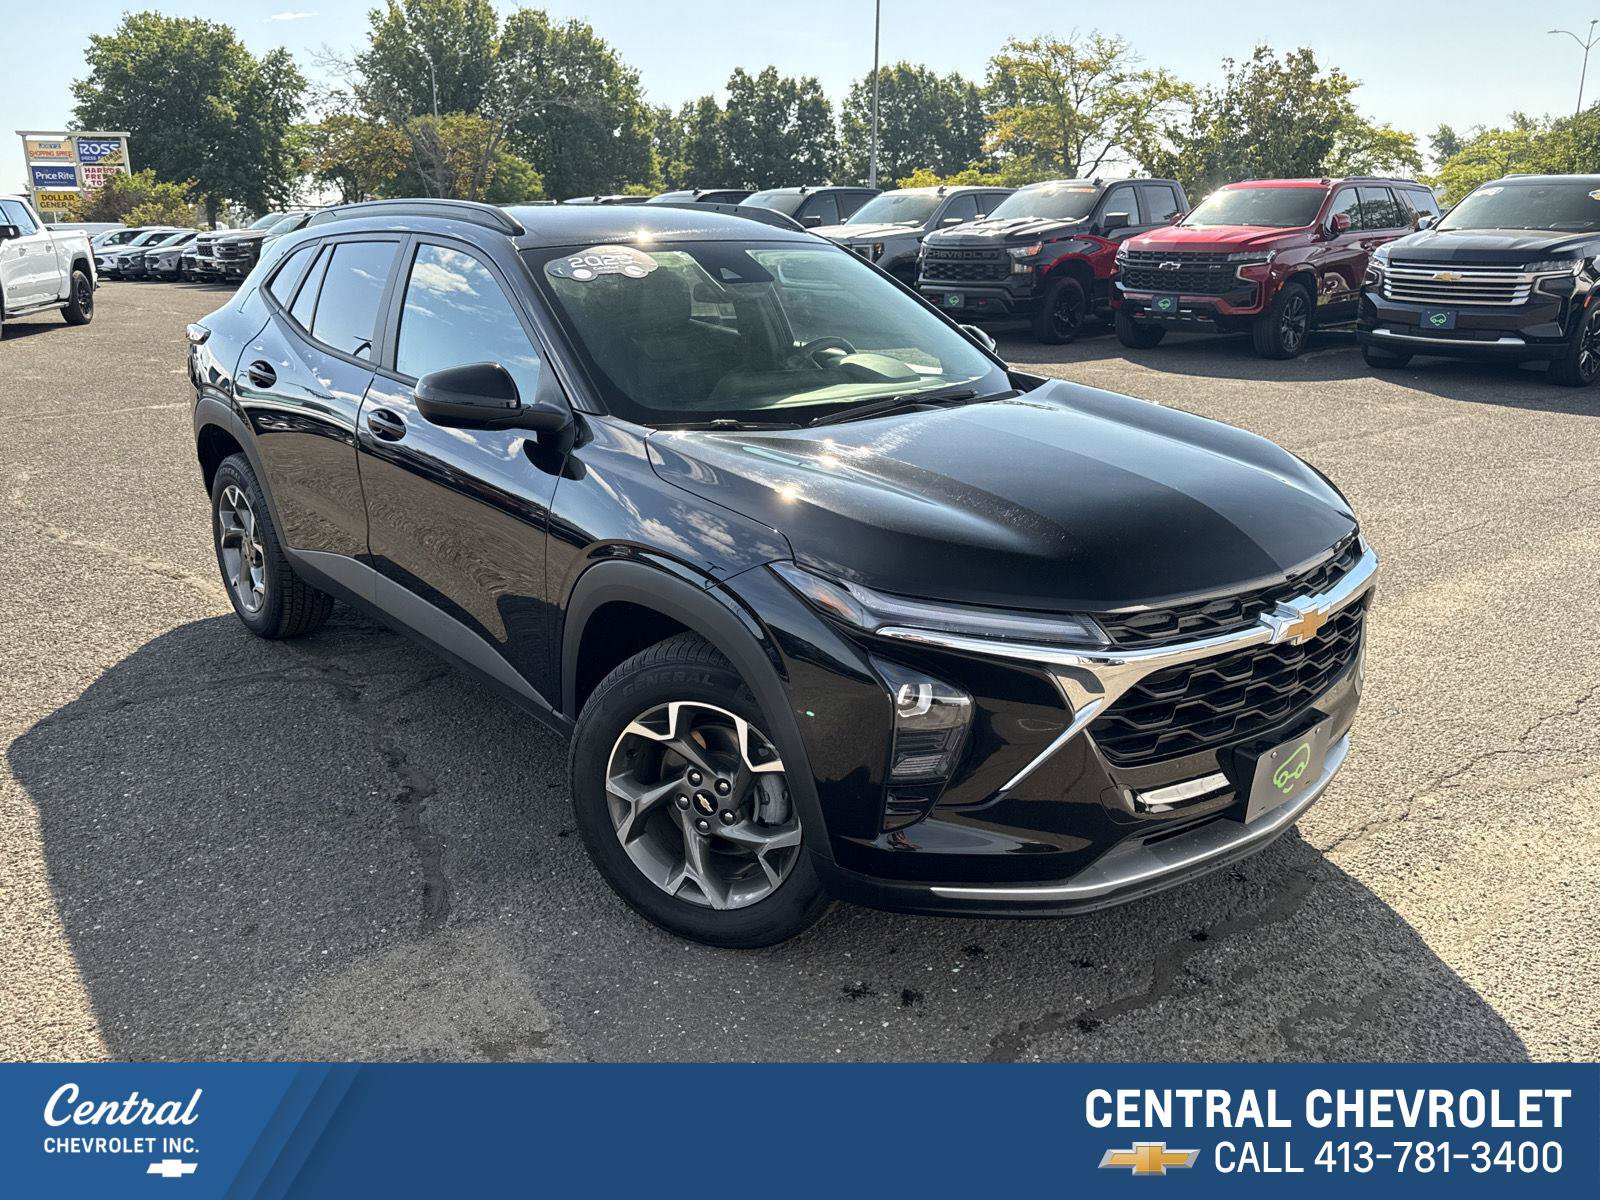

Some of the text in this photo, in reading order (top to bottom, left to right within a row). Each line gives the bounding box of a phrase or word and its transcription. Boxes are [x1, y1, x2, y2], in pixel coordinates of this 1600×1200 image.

[79, 143, 119, 155] ROSS
[40, 194, 76, 202] DOLLAR
[622, 671, 715, 698] GENERAL
